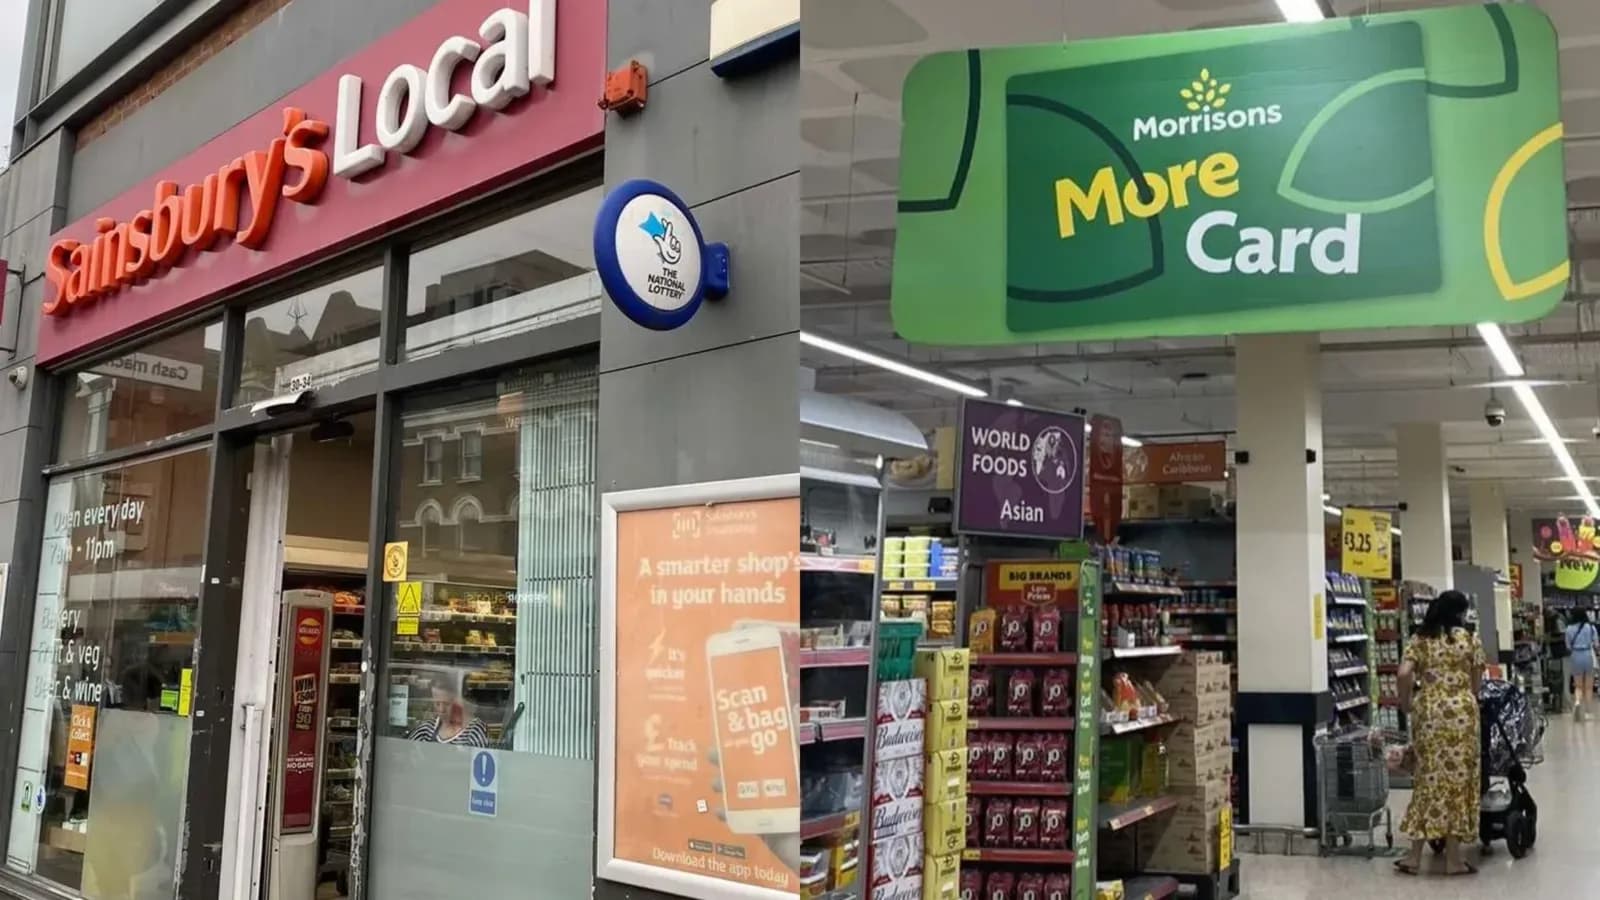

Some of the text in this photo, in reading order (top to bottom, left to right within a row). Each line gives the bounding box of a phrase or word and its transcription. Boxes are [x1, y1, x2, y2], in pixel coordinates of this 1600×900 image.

[1133, 104, 1283, 142] Morrisons
[43, 0, 556, 316] Sainsbury's Local
[1055, 152, 1239, 239] More
[1185, 210, 1361, 275] Card
[648, 274, 686, 291] NATIONAL
[662, 267, 677, 279] THE
[648, 284, 683, 299] LOTTERY
[971, 426, 1031, 452] WORLD
[972, 454, 1028, 478] FOODS
[84, 504, 120, 528] every
[121, 497, 145, 524] day
[1000, 499, 1044, 523] Asian
[85, 536, 113, 564] 11pm
[1344, 531, 1371, 553] £3.25
[640, 557, 652, 577] A
[656, 554, 731, 577] smarter
[1009, 571, 1072, 581] BIG BRANDS
[651, 582, 786, 609] in your hands
[66, 639, 74, 663] &
[79, 645, 100, 671] veg
[62, 675, 71, 699] &
[75, 676, 102, 702] wine
[716, 685, 767, 711] Scan
[727, 706, 788, 732] & bag
[750, 728, 777, 755] go
[652, 847, 705, 869] Download
[708, 854, 731, 874] the
[729, 862, 750, 879] app
[754, 864, 789, 888] today
